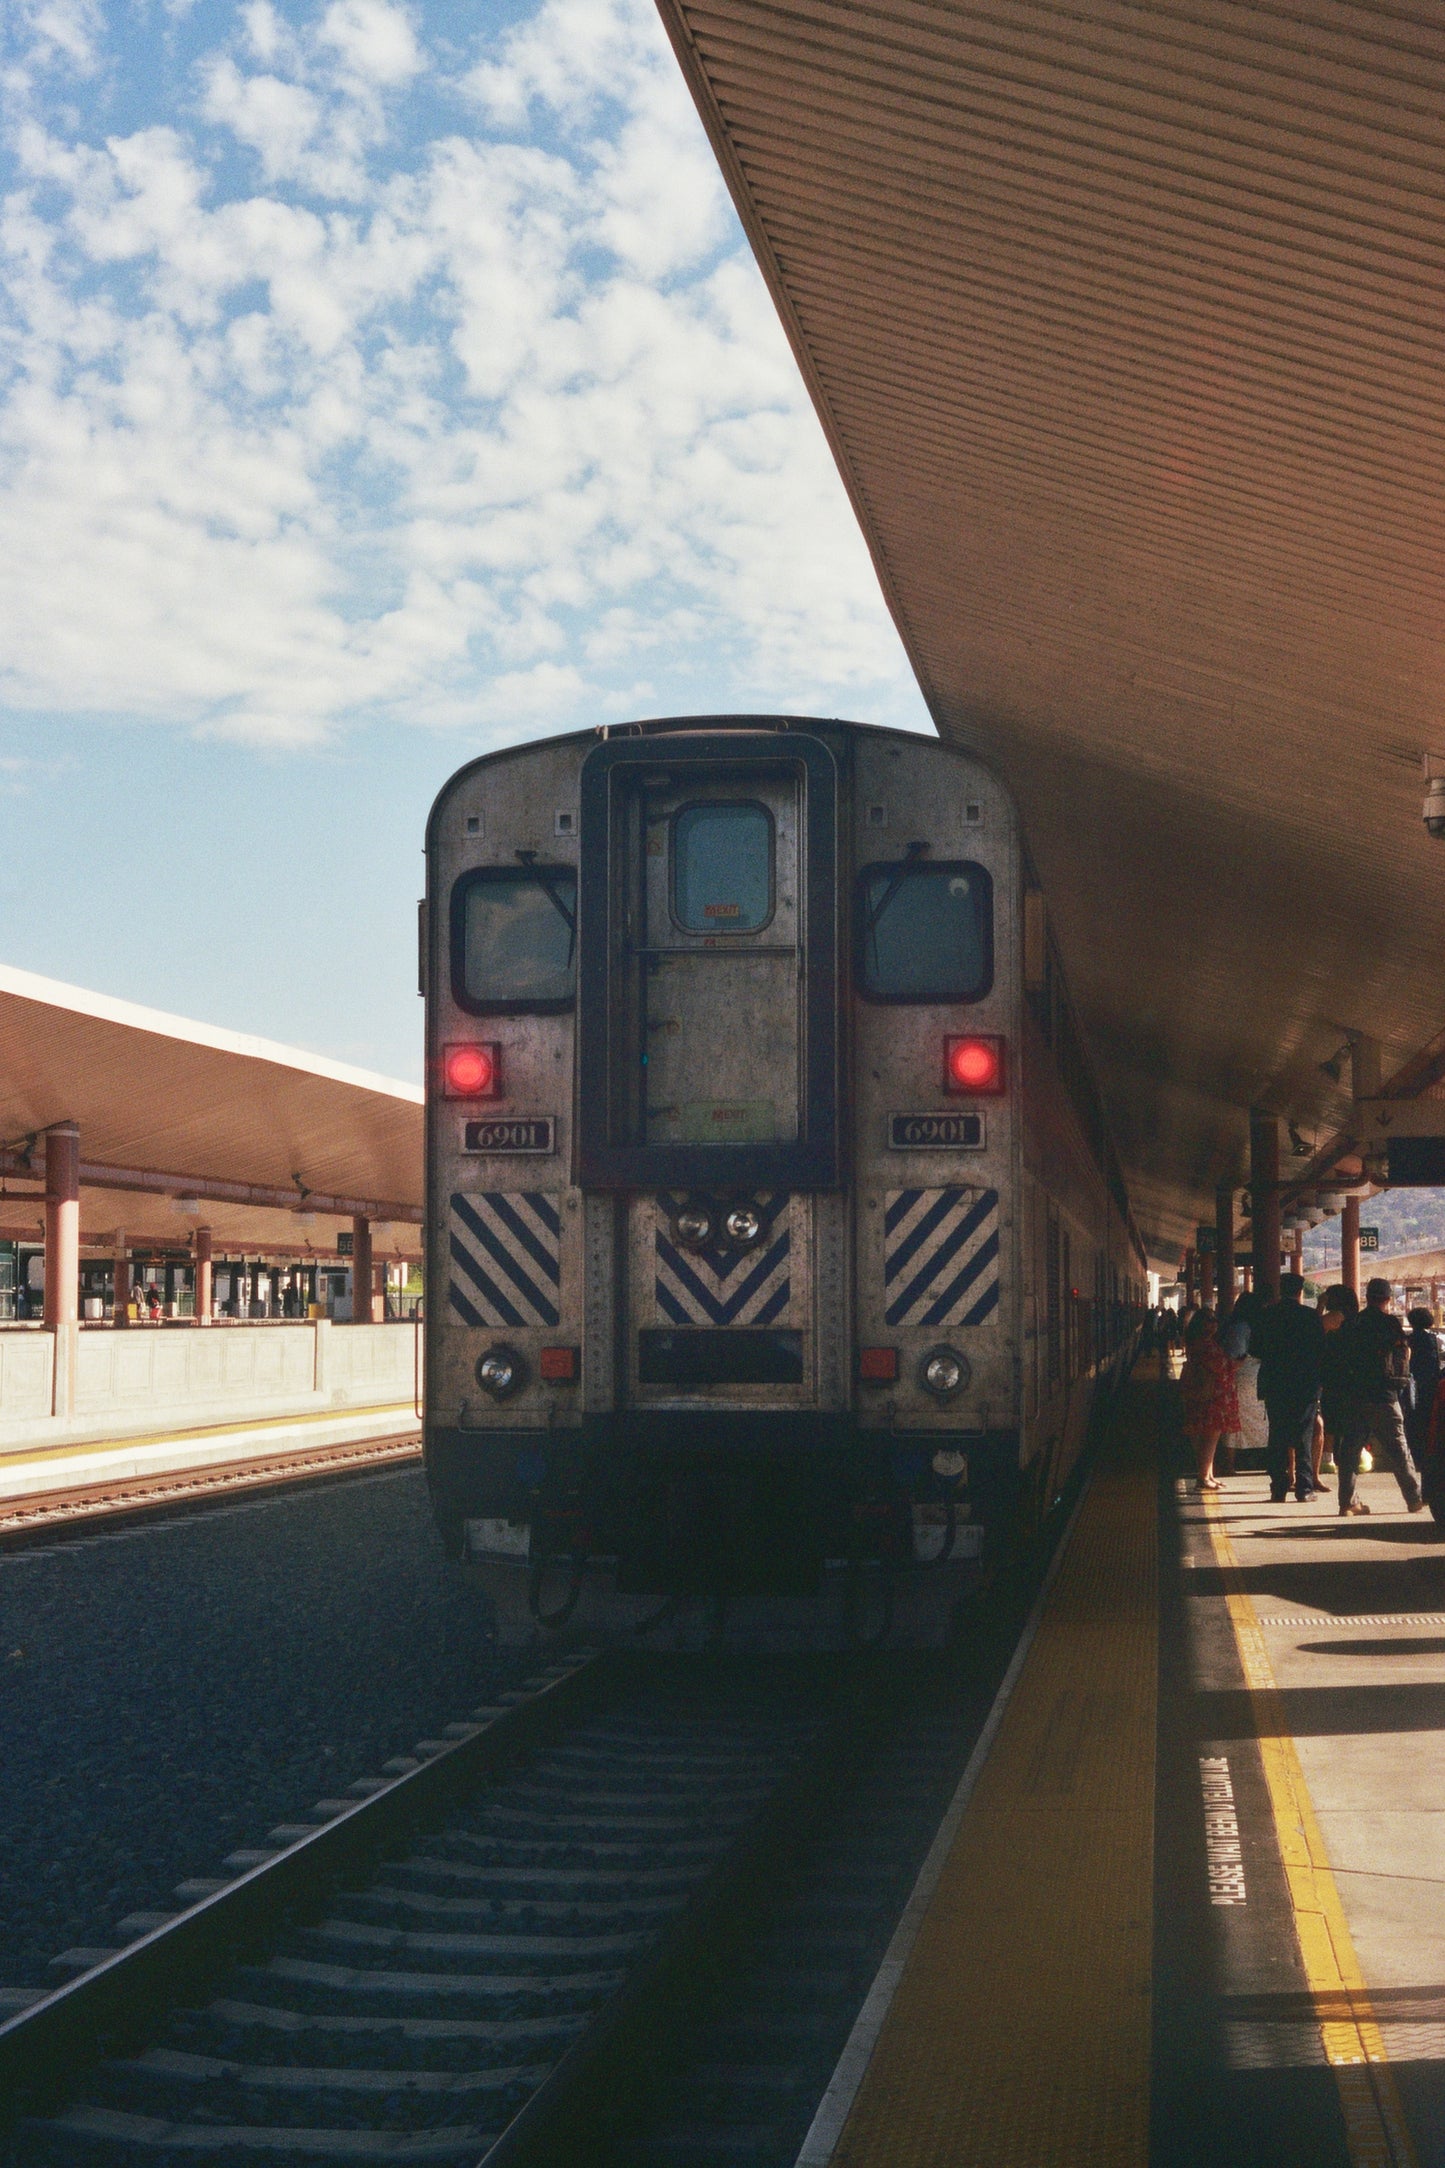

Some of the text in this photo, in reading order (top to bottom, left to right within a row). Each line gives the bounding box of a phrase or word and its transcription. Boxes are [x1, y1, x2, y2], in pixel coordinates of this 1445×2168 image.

[477, 1124, 537, 1147] 6901
[904, 1119, 967, 1142] 6901
[1360, 1236, 1377, 1247] 8B
[1198, 1757, 1247, 1906] PLEASE WAIT BEHIND YELLOW LINE
